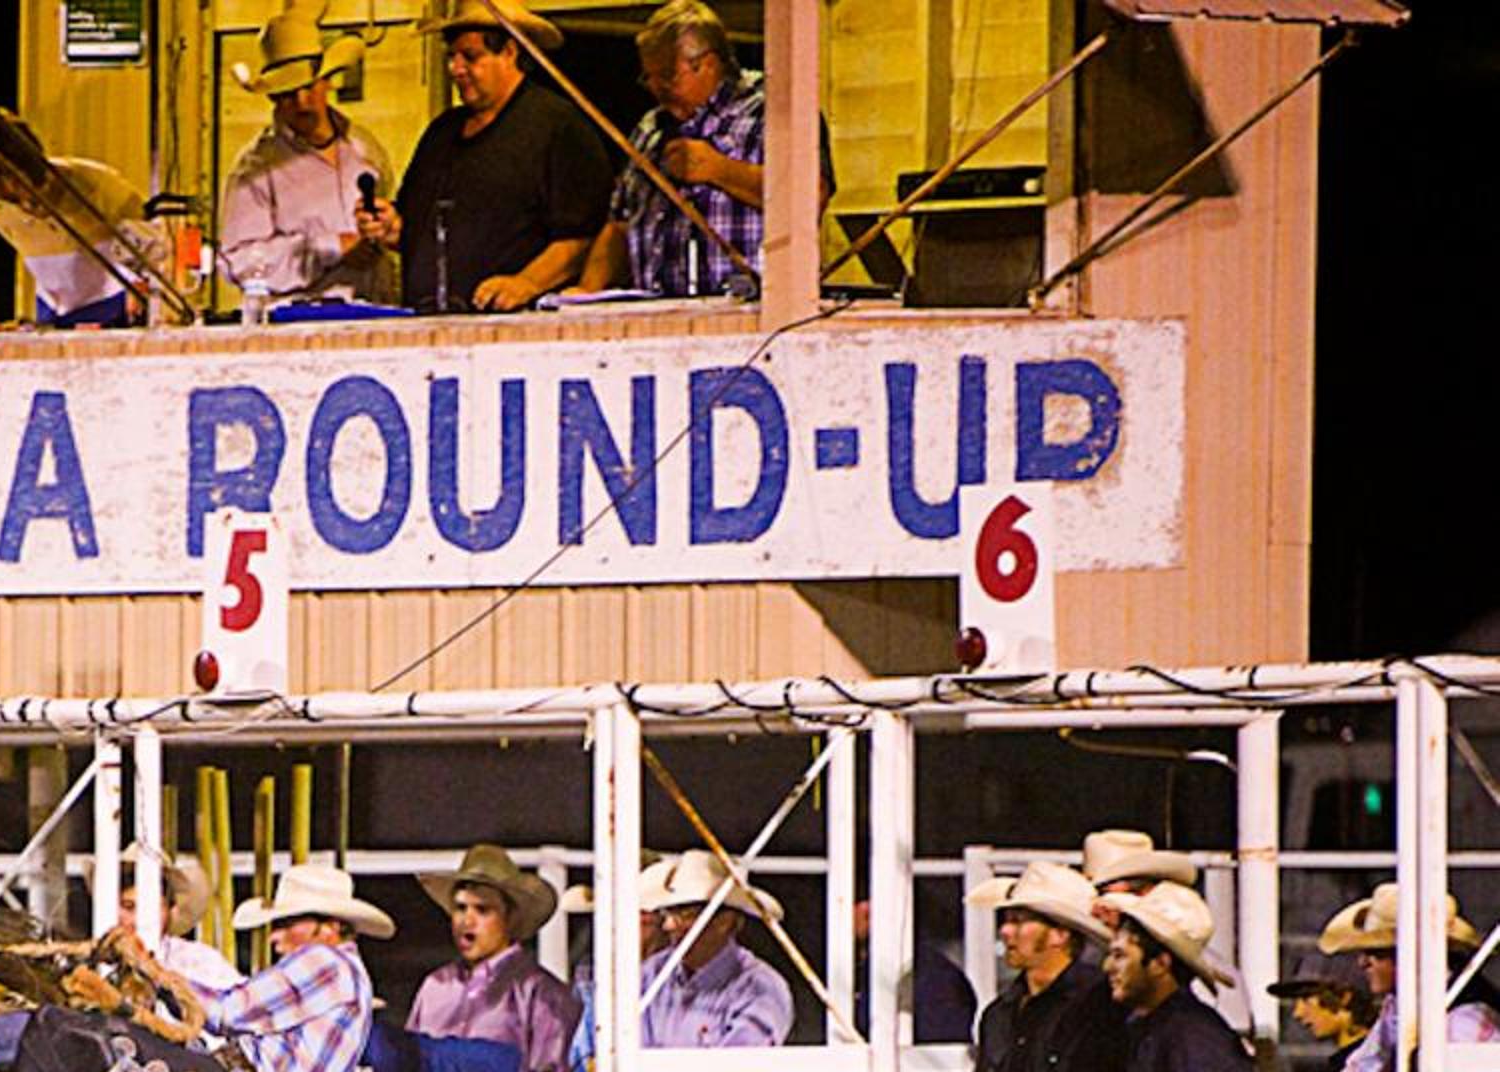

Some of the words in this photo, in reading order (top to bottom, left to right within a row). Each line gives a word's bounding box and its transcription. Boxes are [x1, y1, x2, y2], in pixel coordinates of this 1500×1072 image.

[186, 355, 1122, 558] ROUND-UP
[220, 529, 268, 632] 5
[975, 494, 1039, 603] 6
